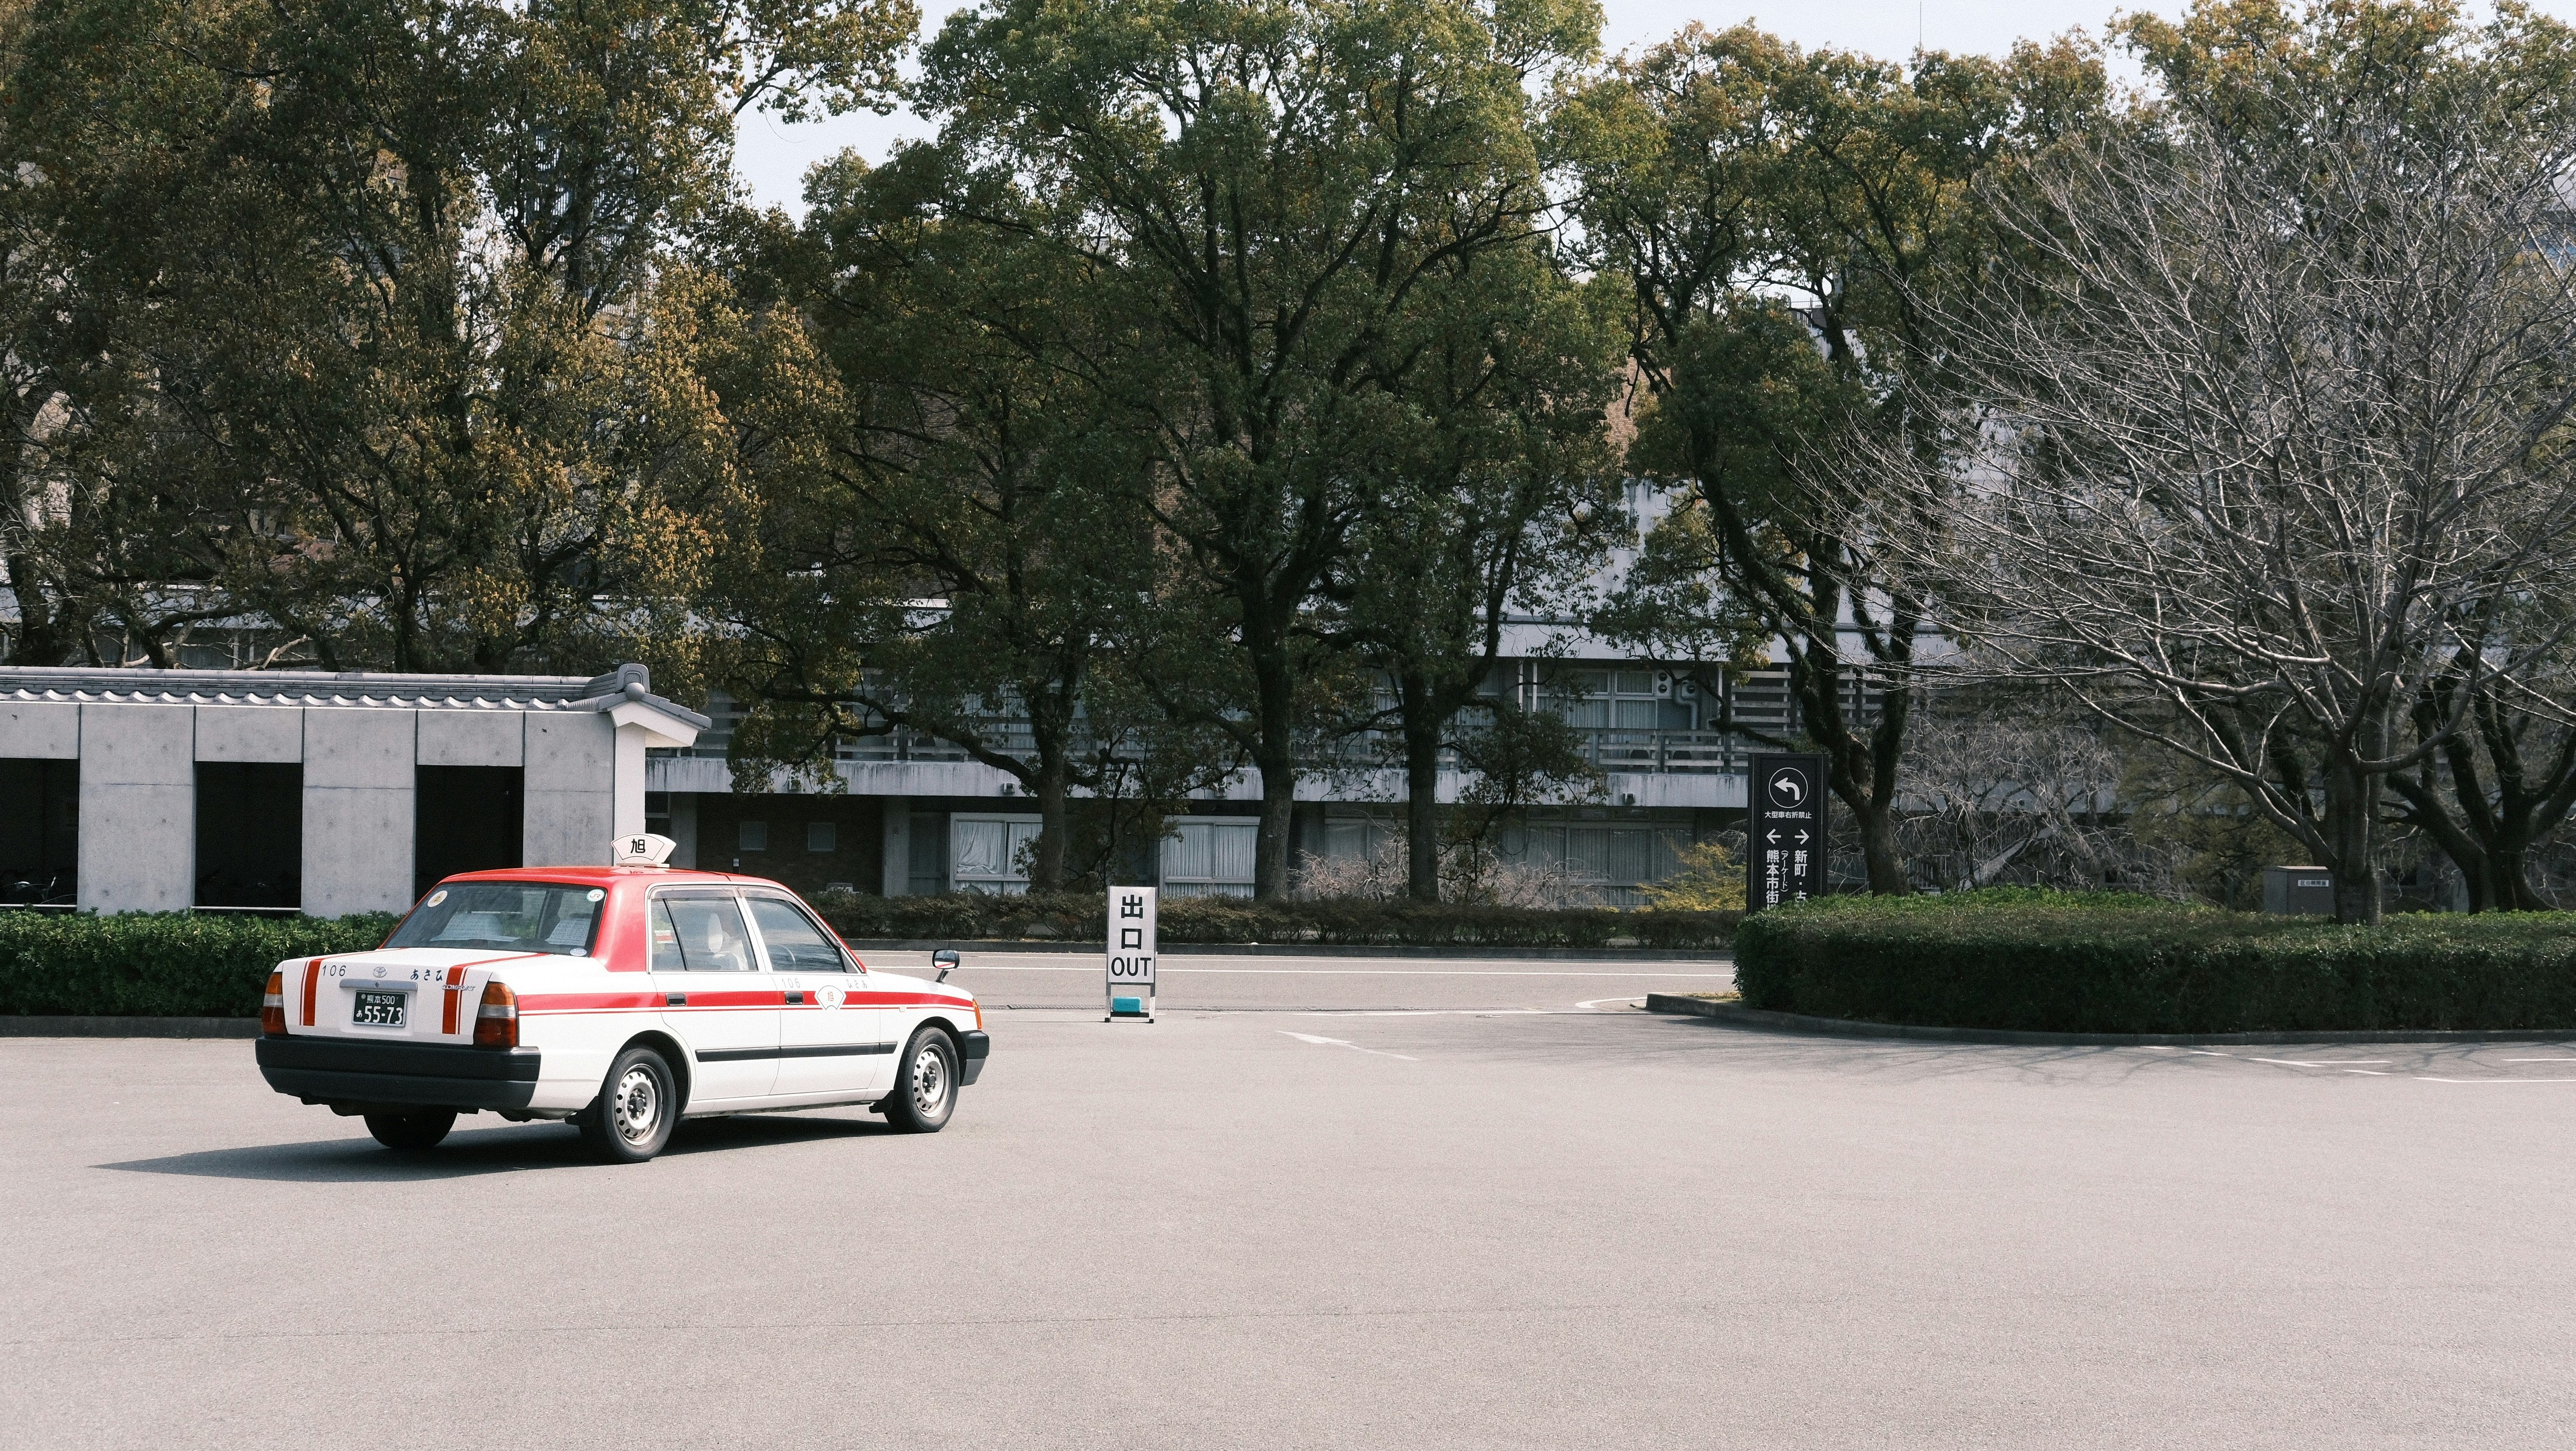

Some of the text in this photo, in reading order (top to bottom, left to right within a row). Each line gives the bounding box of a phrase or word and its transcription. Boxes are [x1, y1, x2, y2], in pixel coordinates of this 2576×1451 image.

[1765, 811, 1812, 819] 大型車右折禁止
[631, 839, 646, 853] 旭
[1121, 895, 1143, 949] 出口
[321, 965, 346, 977] 106
[1111, 957, 1152, 976] OUT
[410, 969, 443, 981] あさひ
[782, 978, 800, 989] 106
[364, 1005, 403, 1024] 55-73
